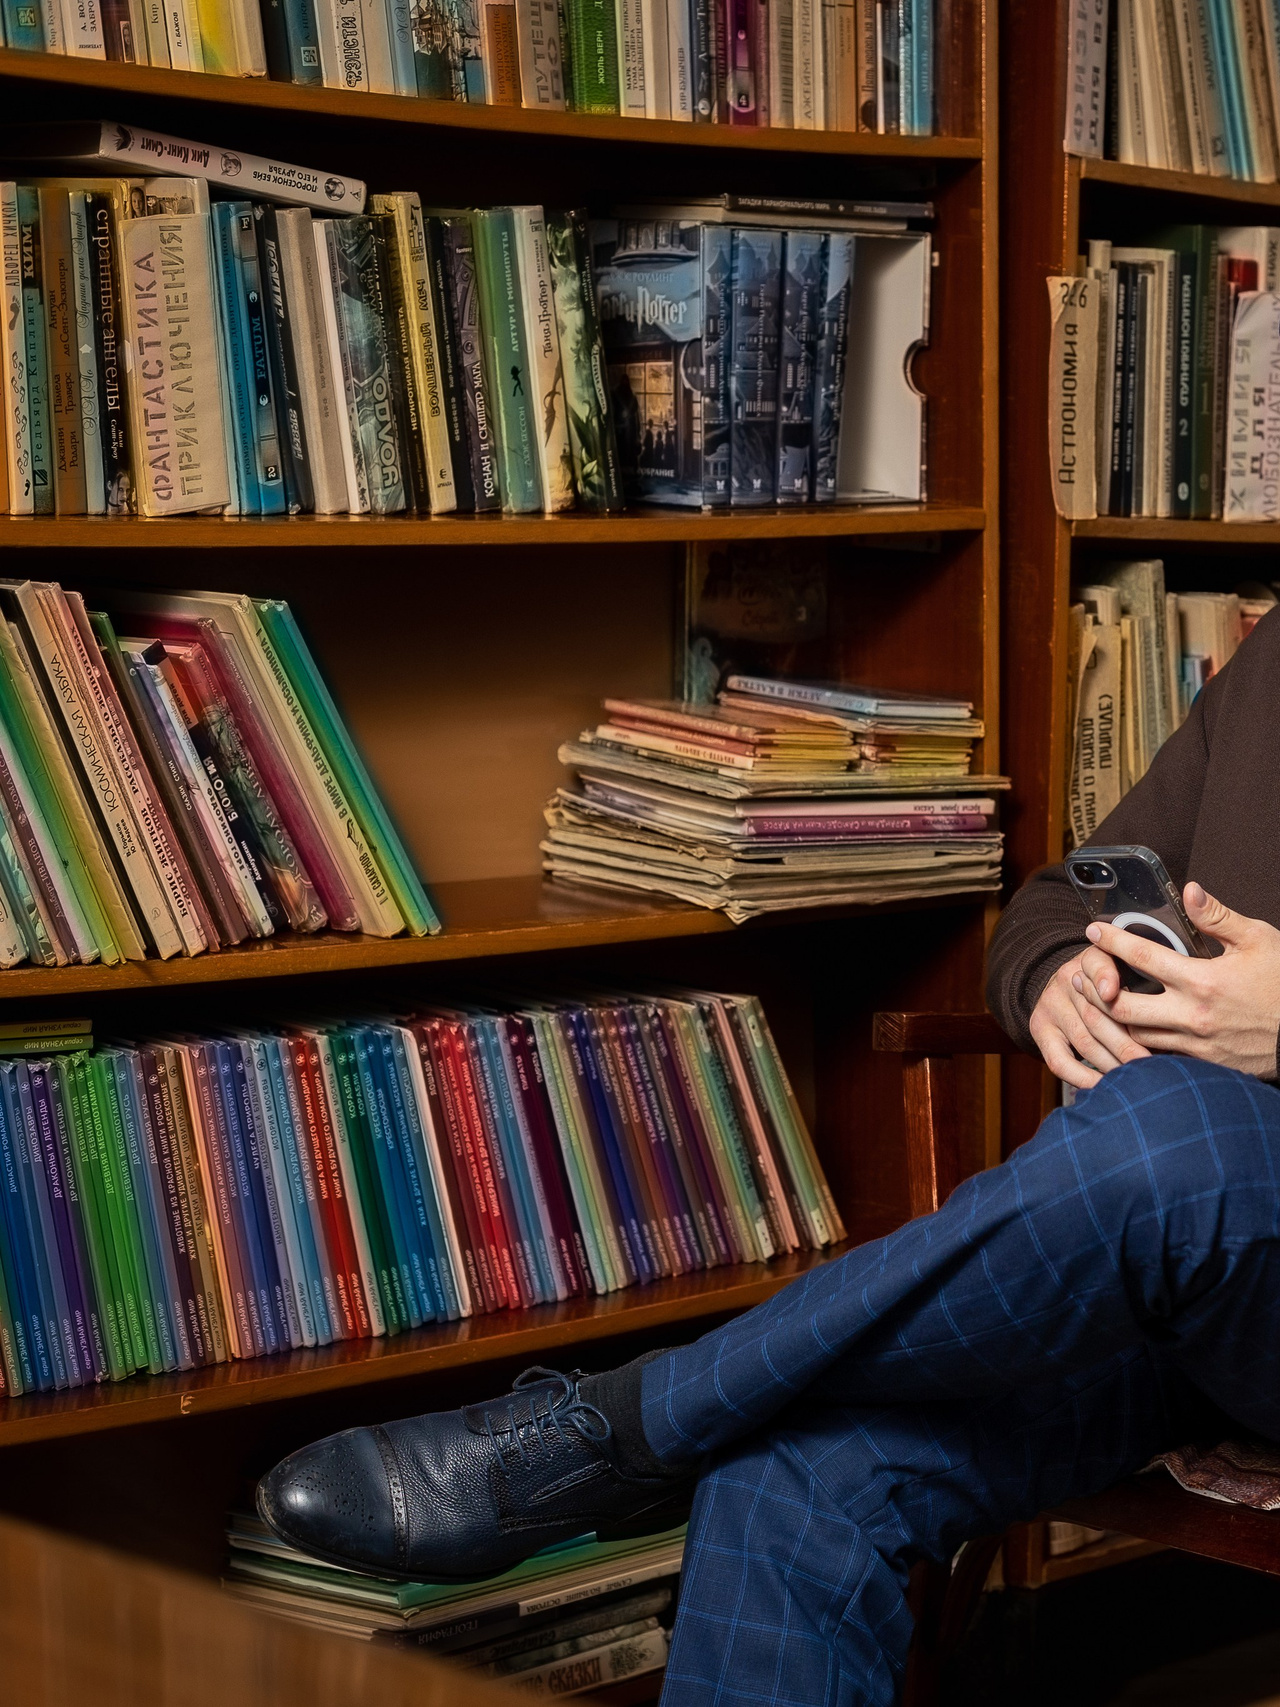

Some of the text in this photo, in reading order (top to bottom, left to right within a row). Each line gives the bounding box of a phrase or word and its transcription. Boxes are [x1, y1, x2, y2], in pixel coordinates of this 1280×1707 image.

[150, 3, 159, 24] Кир
[173, 11, 181, 38] БАЖОВ
[596, 30, 605, 84] ЖЮЛЬ ВЕРН
[191, 149, 210, 168] Дик
[252, 171, 271, 184] БЕЙБ
[268, 165, 318, 184] И ЕГО ДРУЗЬЯ
[1, 200, 20, 287] АЛЬФРЕД ХИЧКОК
[21, 224, 35, 279] КИМ
[48, 290, 58, 330] Антуан
[56, 258, 71, 357] де Сент-Экзюпери
[92, 209, 120, 411] странные ангелы
[220, 227, 240, 371] ОРЕЛ ДЕВЯТОГО ЛЕГИОНА
[501, 231, 519, 352] АРТУР МИНИПУТЫ
[537, 280, 554, 359] Таня Гроттер
[637, 286, 687, 334] Поттер
[159, 225, 203, 496] ПРИКЛЮЧЕНИЯ
[251, 316, 266, 380] FATUM
[397, 307, 418, 431] НЕУКРОТИМАЯ ПЛАНЕТА
[416, 279, 441, 417] ВОЛШЕБНЫЙ МЕЧ
[1180, 275, 1191, 407] СПУТНИКИ ЮПИТЕРА
[25, 295, 44, 463] Редьярд Киплинг
[54, 374, 65, 414] Памела
[65, 372, 76, 415] Трэверс
[133, 252, 173, 500] ФАНТАСТИКА
[472, 361, 483, 388] МАГА
[57, 427, 68, 473] Джанни
[68, 431, 80, 468] Родари
[372, 377, 398, 489] УОЛДО
[518, 406, 530, 442] БЕССОН
[1230, 339, 1250, 511] ХИМИЯ
[1250, 387, 1265, 480] ДЛЯ
[480, 455, 495, 498] КОНАН
[45, 653, 123, 812] КОСМИЧЕСКАЯ АЗБУКА
[100, 712, 111, 723] О
[257, 637, 348, 819] В МИРЕ ДЕЛЬФИНА И ОСЬМИНОГА
[104, 724, 142, 795] РАССКАЗЫ
[1081, 718, 1095, 786] О ЖИВОЙ
[167, 760, 193, 811] СКАЗКИ СТИХИ
[112, 822, 130, 850] Горьков
[118, 818, 134, 845] Авдеев
[137, 807, 171, 869] ЖИТКОВ
[203, 787, 233, 837] ФЕДОРИНО
[229, 845, 246, 871] ГОРЕ
[25, 838, 51, 881] ИВАНОВ
[239, 840, 264, 881] Акимушкин
[358, 852, 382, 889] САХАРНОВ
[163, 872, 190, 918] БОРИС
[40, 1040, 64, 1048] УЗНАЙ
[160, 1081, 175, 1130] НАСЕКОМЫЕ
[247, 1076, 260, 1112] БУДУЩЕЕ
[342, 1074, 357, 1118] КОРАБЛИ
[363, 1071, 383, 1138] КРЕСТОНОСЦЫ
[424, 1060, 437, 1095] ЛОШАДИ
[14, 1106, 29, 1163] ДИНОЗАВРЫ
[25, 1105, 41, 1162] ДИНОЗАВРЫ
[38, 1098, 51, 1141] ЛЕГЕНДЫ
[71, 1095, 88, 1162] ДРЕВНИЙ РИМ
[87, 1080, 114, 1193] ДРЕВНЯЯ МЕСОПОТАМИЯ
[123, 1093, 140, 1164] ДРЕВНЯЯ РУСЬ
[224, 1082, 250, 1196] ИСТОРИЯ САНКТ-ПЕТЕРБУРГА
[254, 1123, 270, 1169] НАСТОЯЩЕЕ
[299, 1071, 329, 1198] КНИГА БУДУЩЕГО КОМАНДИРА
[460, 1061, 501, 1216] МИНЕРАЛЫ ДРАГОЦЕННЫЕ КАМНИ
[4, 1151, 17, 1193] ДИНАСТИЯ
[47, 1152, 62, 1198] ДРАКОНЫ
[152, 1092, 186, 1253] ЖИВОТНЫЕ ИЗ КРАСНОЙ КНИГИ РОССИИ
[168, 1133, 186, 1195] УДИВИТЕЛЬНЫЕ
[171, 1085, 205, 1236] ЗАГАДКИ ДРЕВНИХ ЦИВИЛИЗАЦИЙ
[201, 1085, 230, 1224] ИСТОРИЯ АРХИТЕКТУРНЫХ СТИЛЕЙ
[179, 1197, 192, 1227] ДРУГИЕ
[263, 1171, 284, 1244] НАНОТЕХНОЛОГИИ:
[186, 1238, 196, 1260] ЖУКИ
[418, 1619, 479, 1645] ГЕОГРАФИЯ
